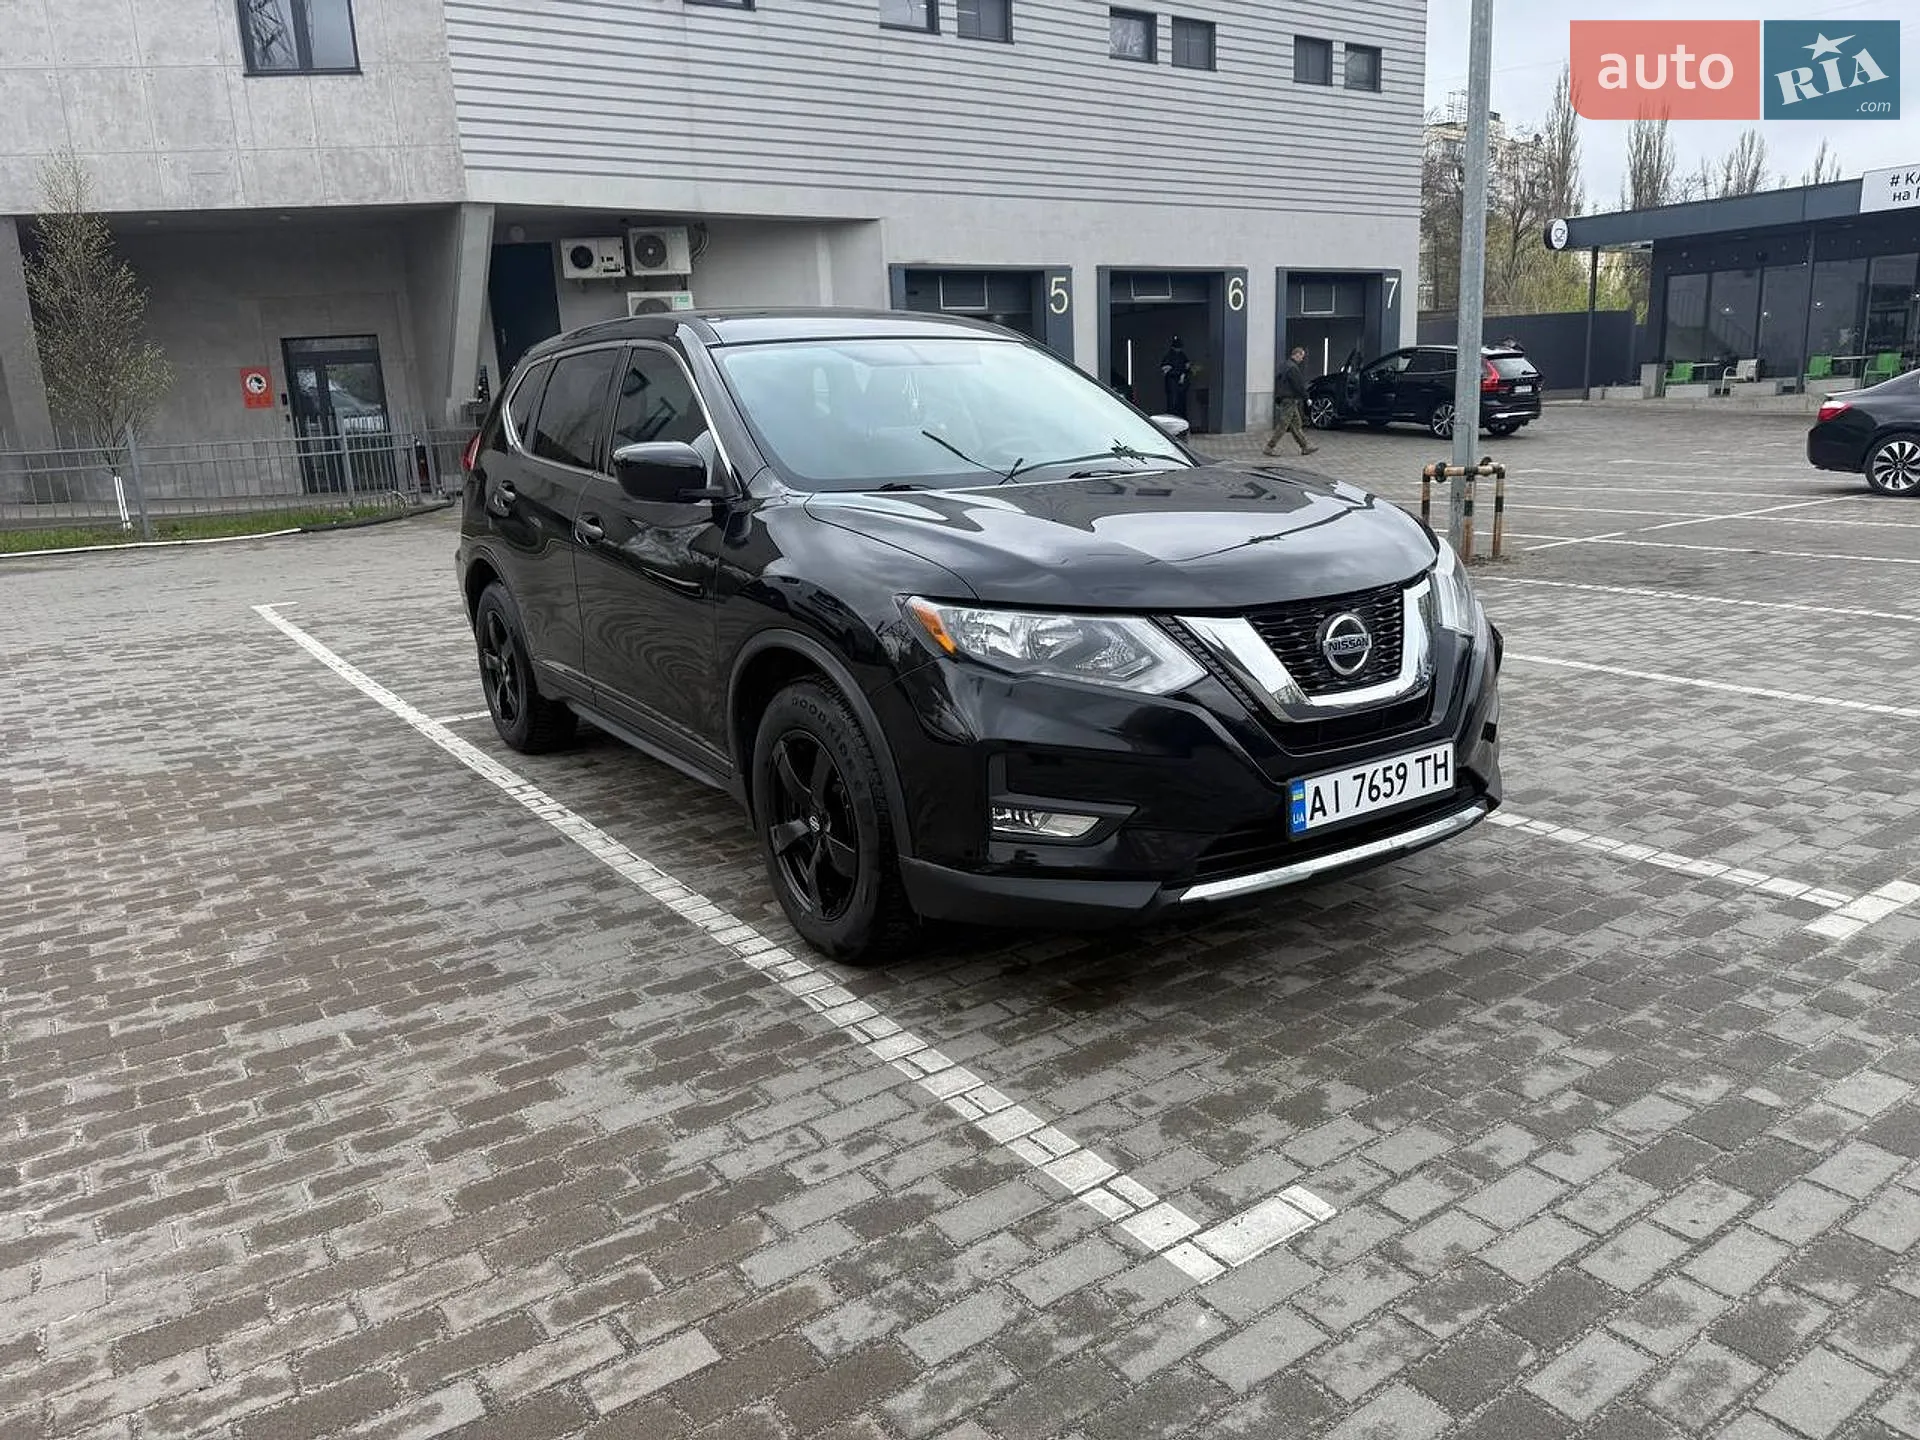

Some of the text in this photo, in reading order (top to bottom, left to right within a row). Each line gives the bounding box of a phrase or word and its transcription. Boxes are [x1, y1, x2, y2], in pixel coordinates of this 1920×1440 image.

[1050, 276, 1068, 314] 5
[1228, 276, 1244, 311] 6
[1385, 276, 1399, 310] 7
[1329, 637, 1369, 651] NISSAN
[1309, 750, 1448, 821] AI 7659 TH
[1293, 814, 1305, 825] UA
